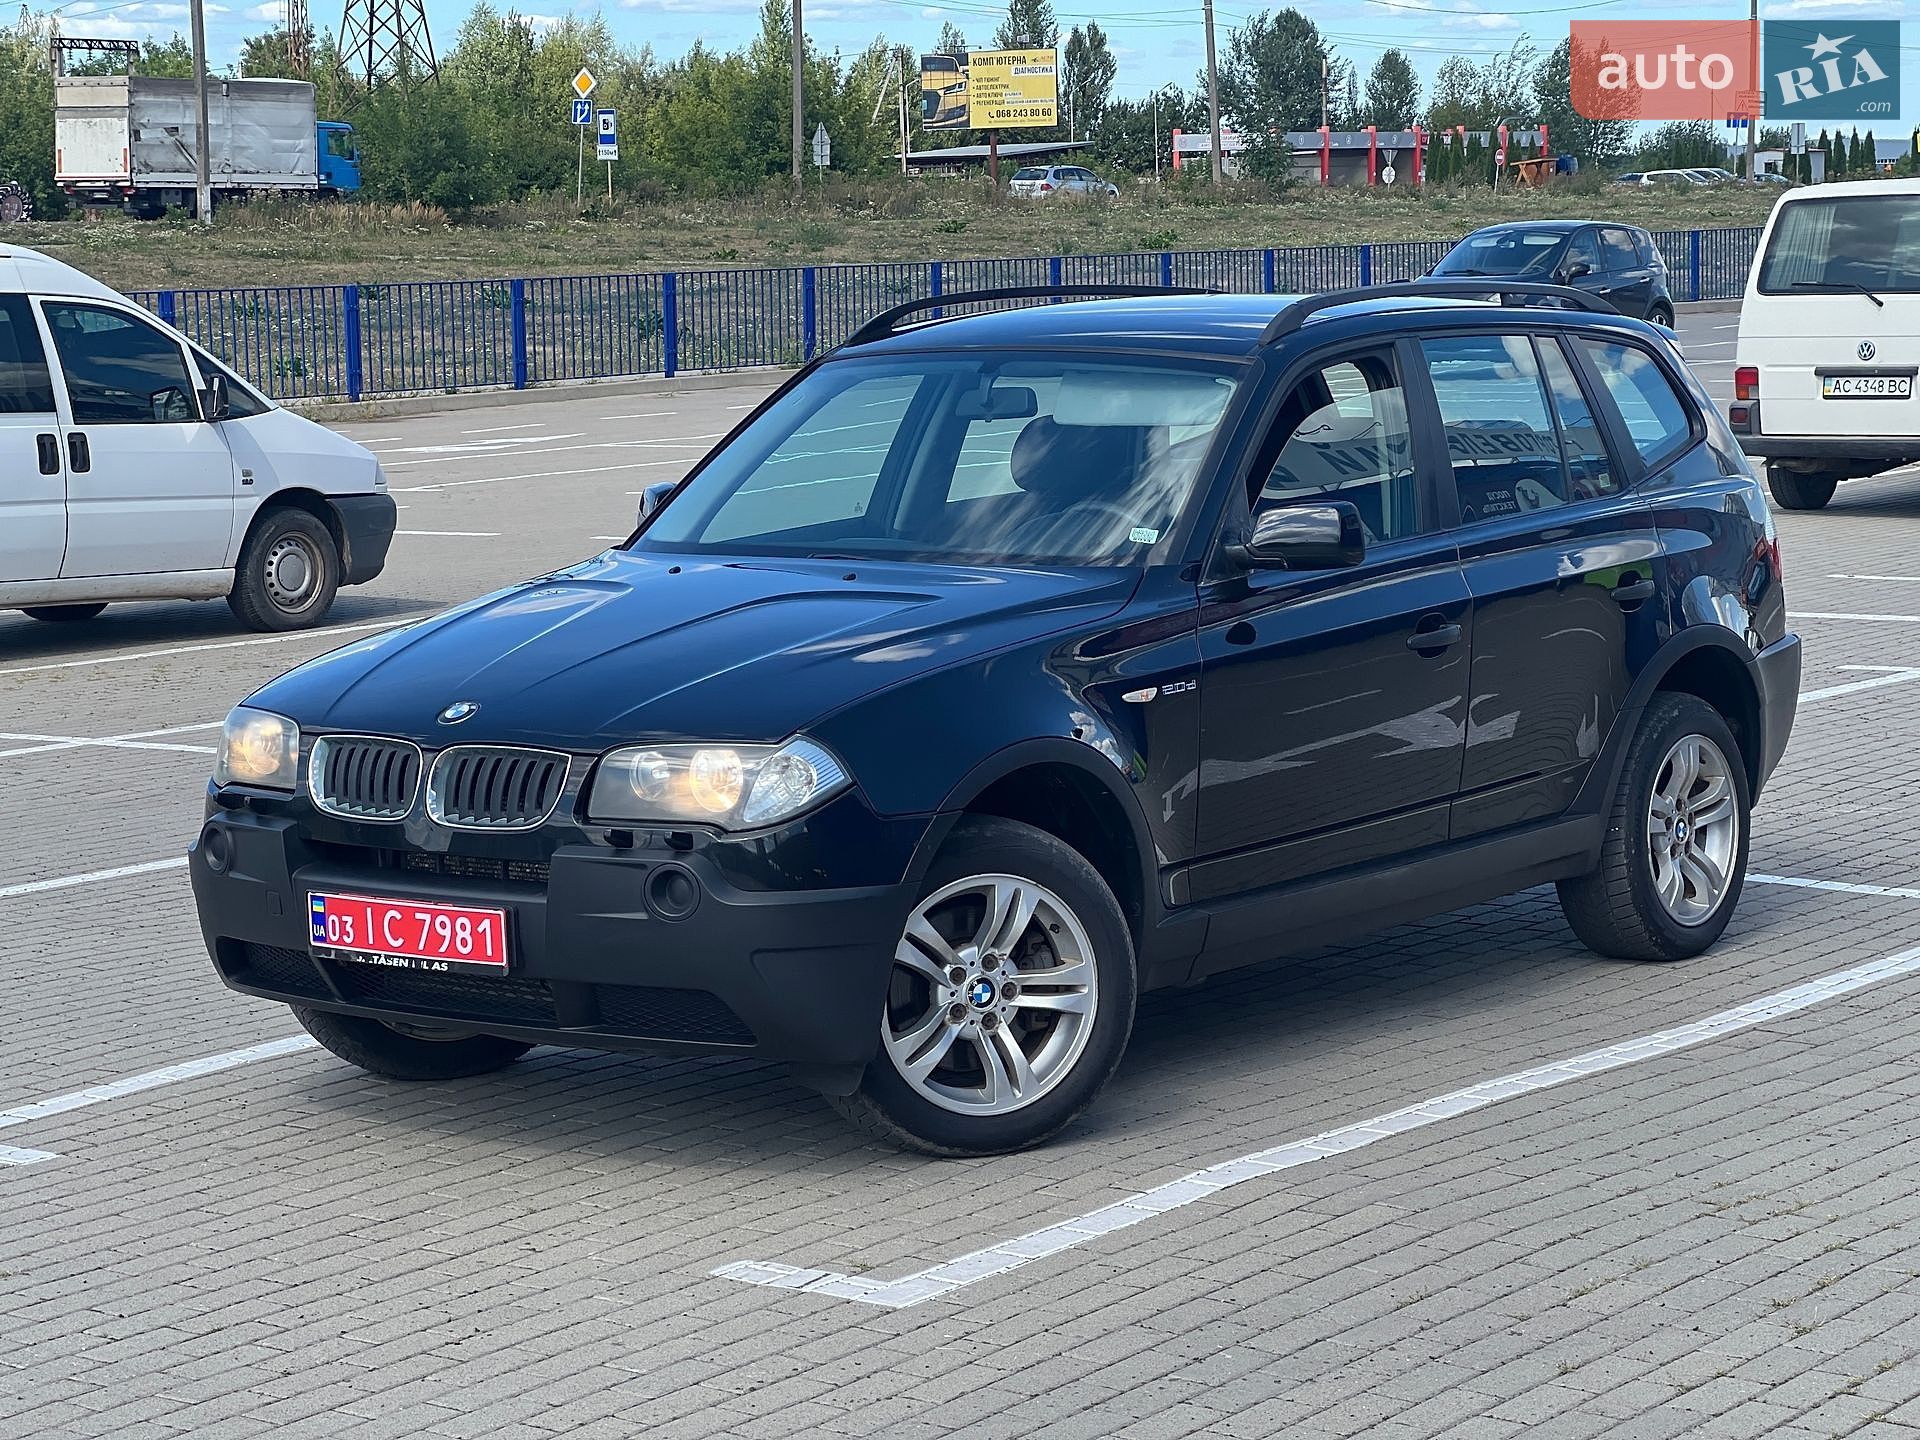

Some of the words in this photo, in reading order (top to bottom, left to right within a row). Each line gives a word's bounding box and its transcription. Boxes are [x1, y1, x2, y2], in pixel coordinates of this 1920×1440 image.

[972, 56, 1027, 66] КОМП'ЮТЕРНА
[1014, 66, 1053, 75] ДІАГНОСТИКА
[996, 109, 1011, 118] 068
[1013, 109, 1028, 118] 243
[1030, 108, 1040, 117] 80
[1042, 108, 1052, 116] 60
[1833, 380, 1851, 393] AC
[1855, 380, 1884, 393] 4348
[1888, 380, 1907, 393] BC
[313, 923, 326, 937] UA
[327, 914, 354, 944] 03
[414, 912, 493, 957] 7981
[432, 961, 448, 972] AS
